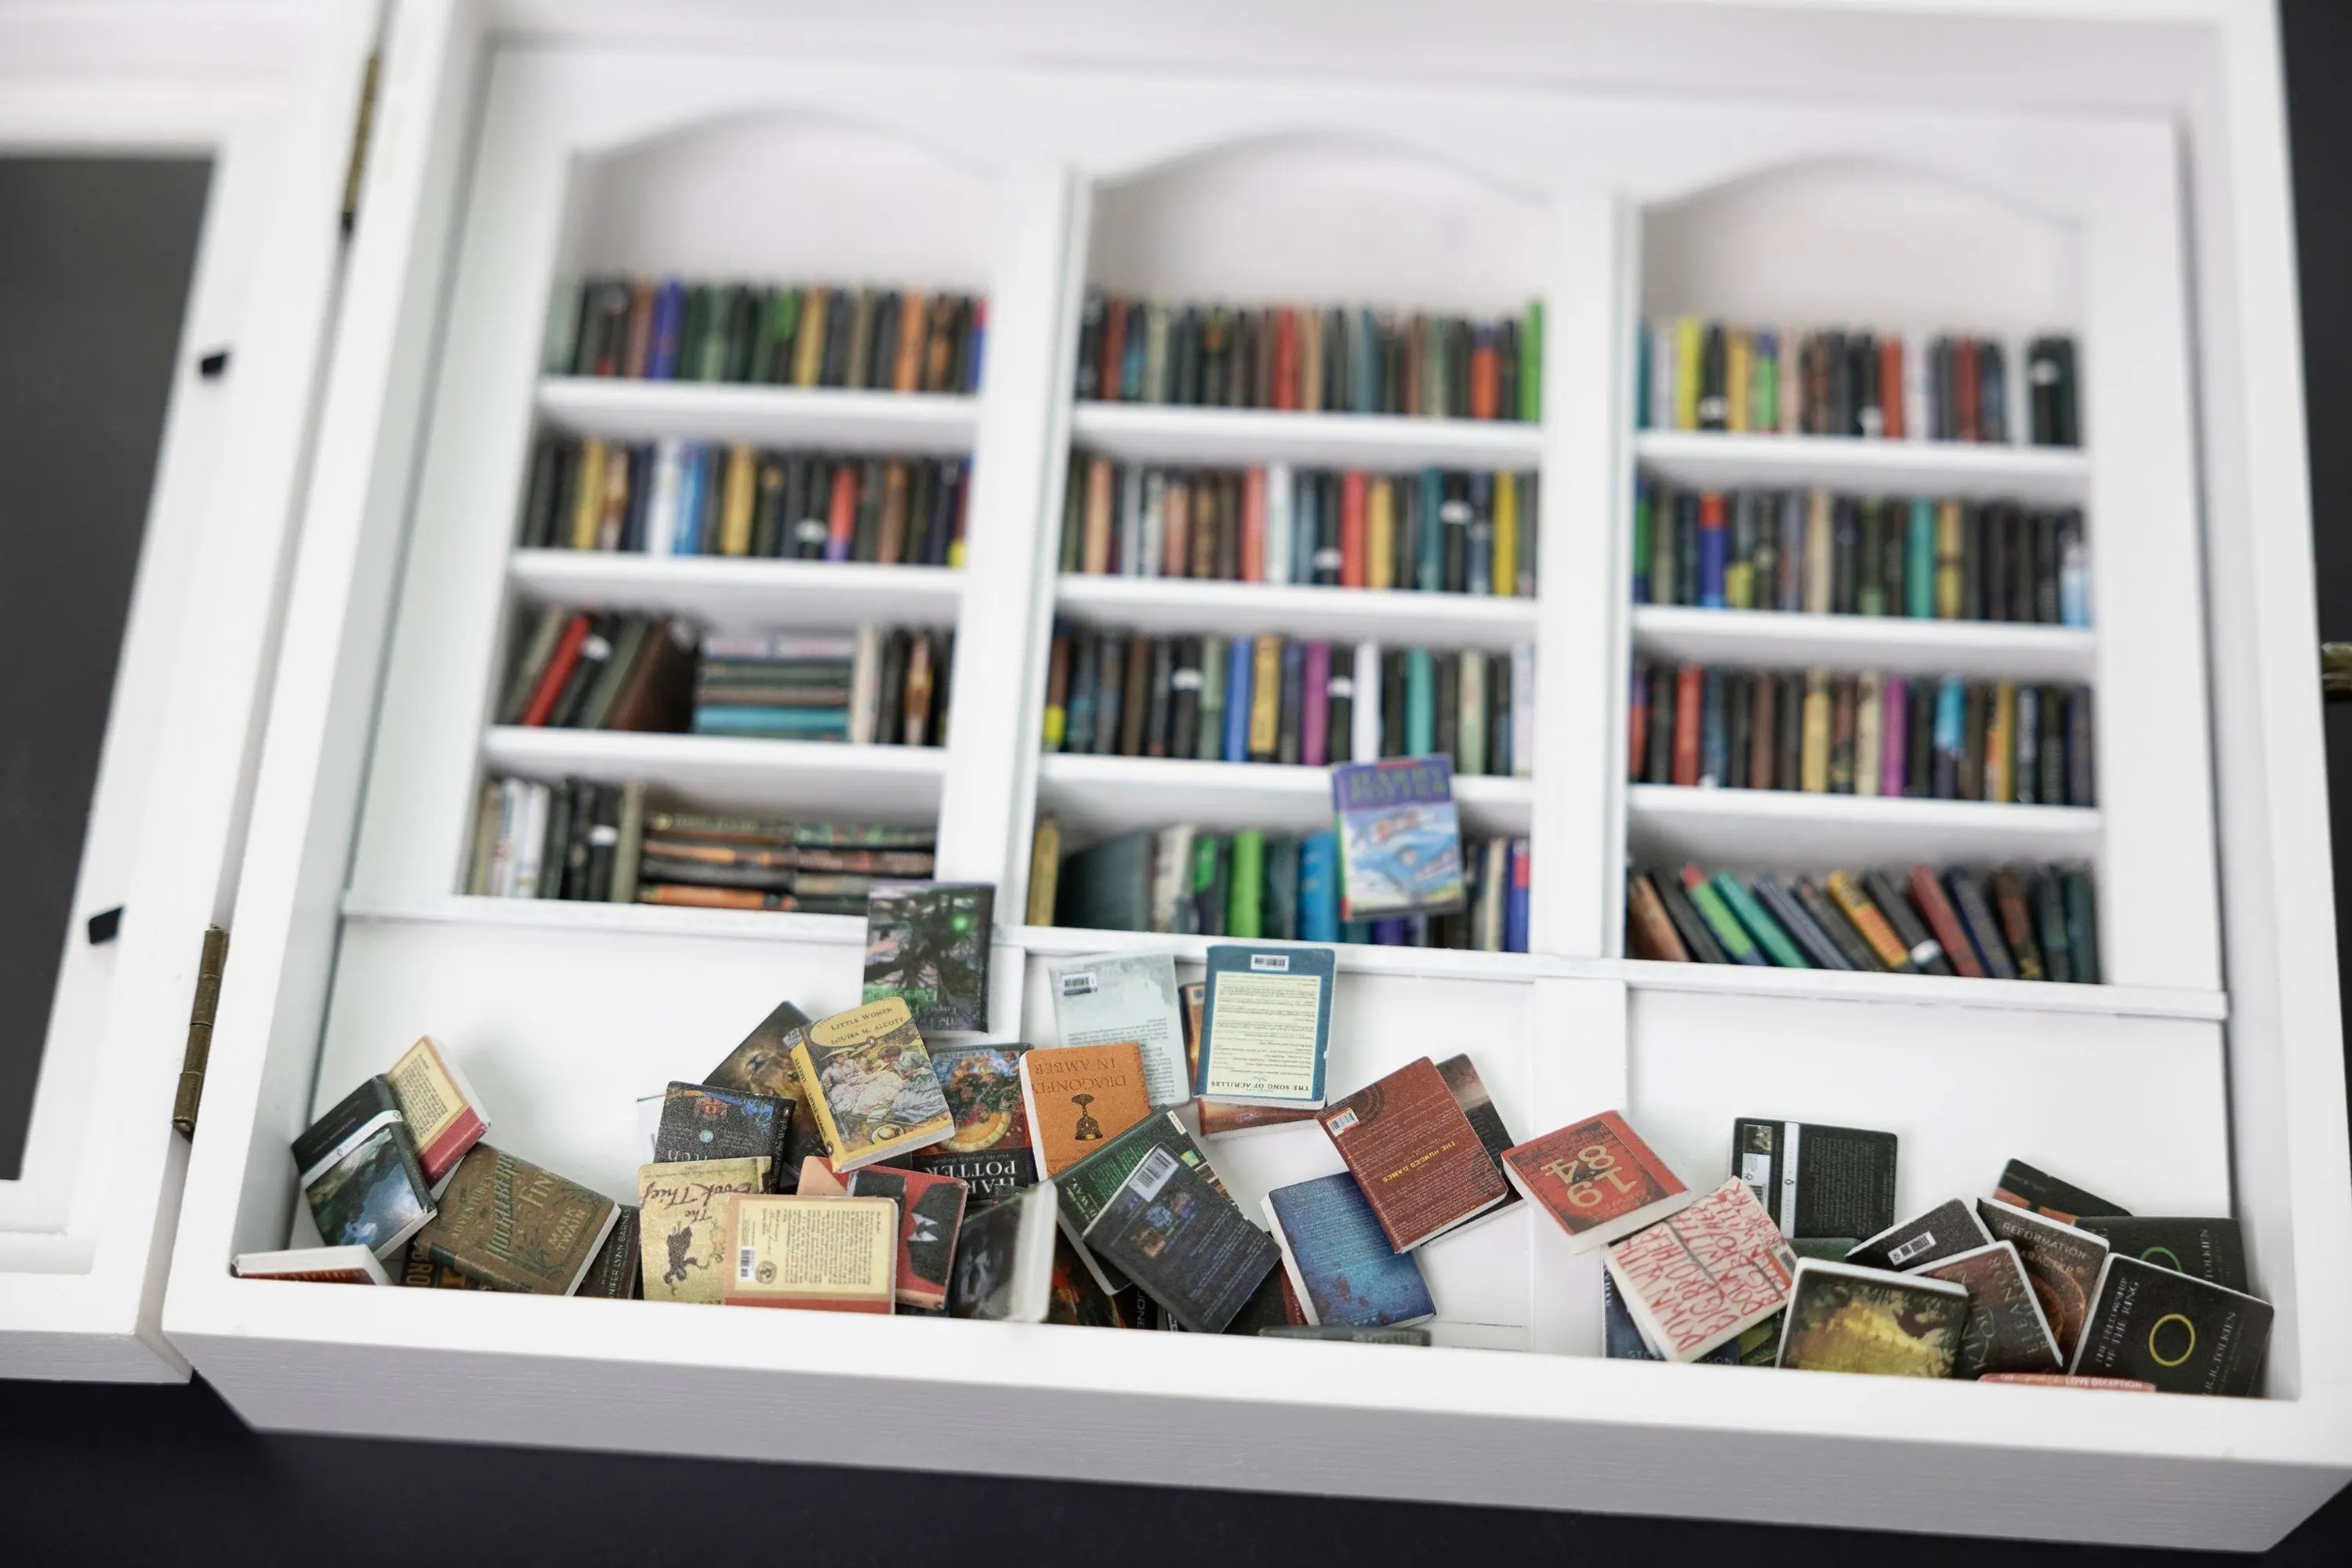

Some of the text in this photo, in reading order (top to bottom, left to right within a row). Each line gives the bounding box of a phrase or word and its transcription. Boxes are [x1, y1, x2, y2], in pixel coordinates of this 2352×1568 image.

[830, 1018, 859, 1030] LITTLE
[861, 1007, 893, 1022] WOMEN
[1034, 1058, 1116, 1074] IN AMBER
[1381, 1140, 1457, 1183] THE HUNGER GAMES
[1540, 1140, 1617, 1185] 84
[641, 1183, 698, 1207] Thief
[1563, 1163, 1639, 1214] 19
[546, 1204, 575, 1247] MARK
[686, 1211, 713, 1222] The
[1638, 1225, 1741, 1338] BIG BROTHER
[1715, 1268, 1764, 1318] DOWN
[2121, 1280, 2141, 1315] RING
[1645, 1286, 1708, 1355] DOWN
[2212, 1312, 2238, 1362] TOLKIEN
[2065, 1377, 2089, 1385] LOVE
